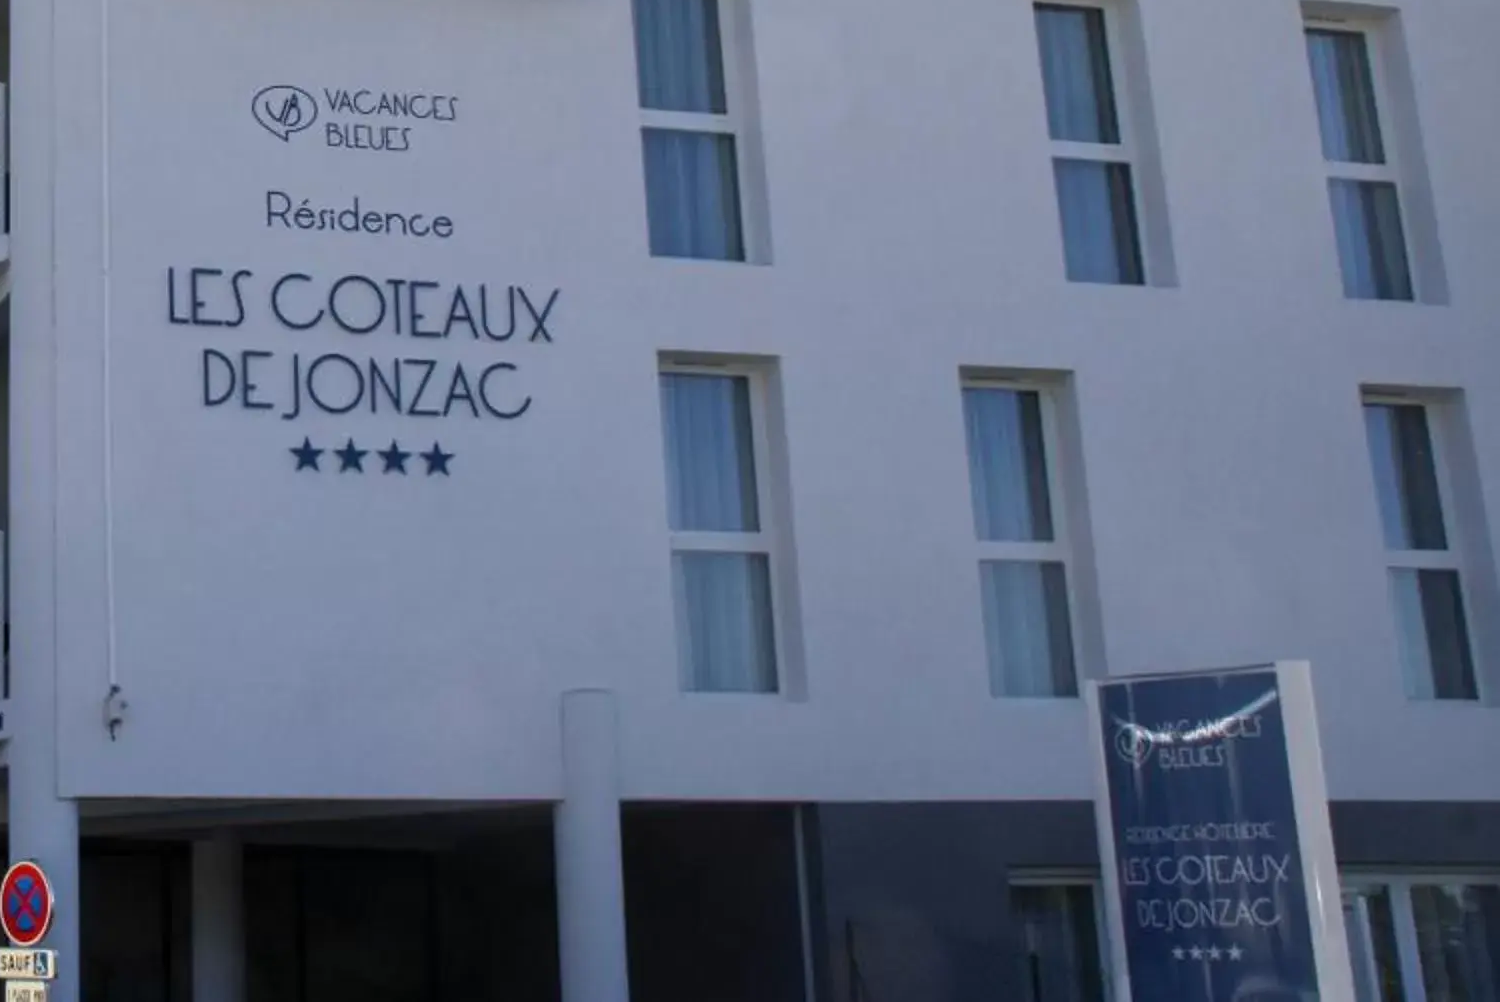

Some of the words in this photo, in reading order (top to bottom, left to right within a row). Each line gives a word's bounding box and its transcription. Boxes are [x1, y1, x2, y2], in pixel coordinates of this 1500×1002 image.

[323, 88, 459, 121] VACANCES
[325, 122, 413, 152] BLEUES
[266, 189, 454, 238] Résidence
[168, 266, 253, 328] LES
[270, 272, 561, 344] COTEAUX
[202, 348, 275, 411] DE
[281, 353, 533, 421] JONZAC
[1122, 856, 1150, 886] LES
[1155, 854, 1290, 886] COTEAUX
[1165, 898, 1282, 932] JONZAC
[0, 954, 31, 972] SAUF
